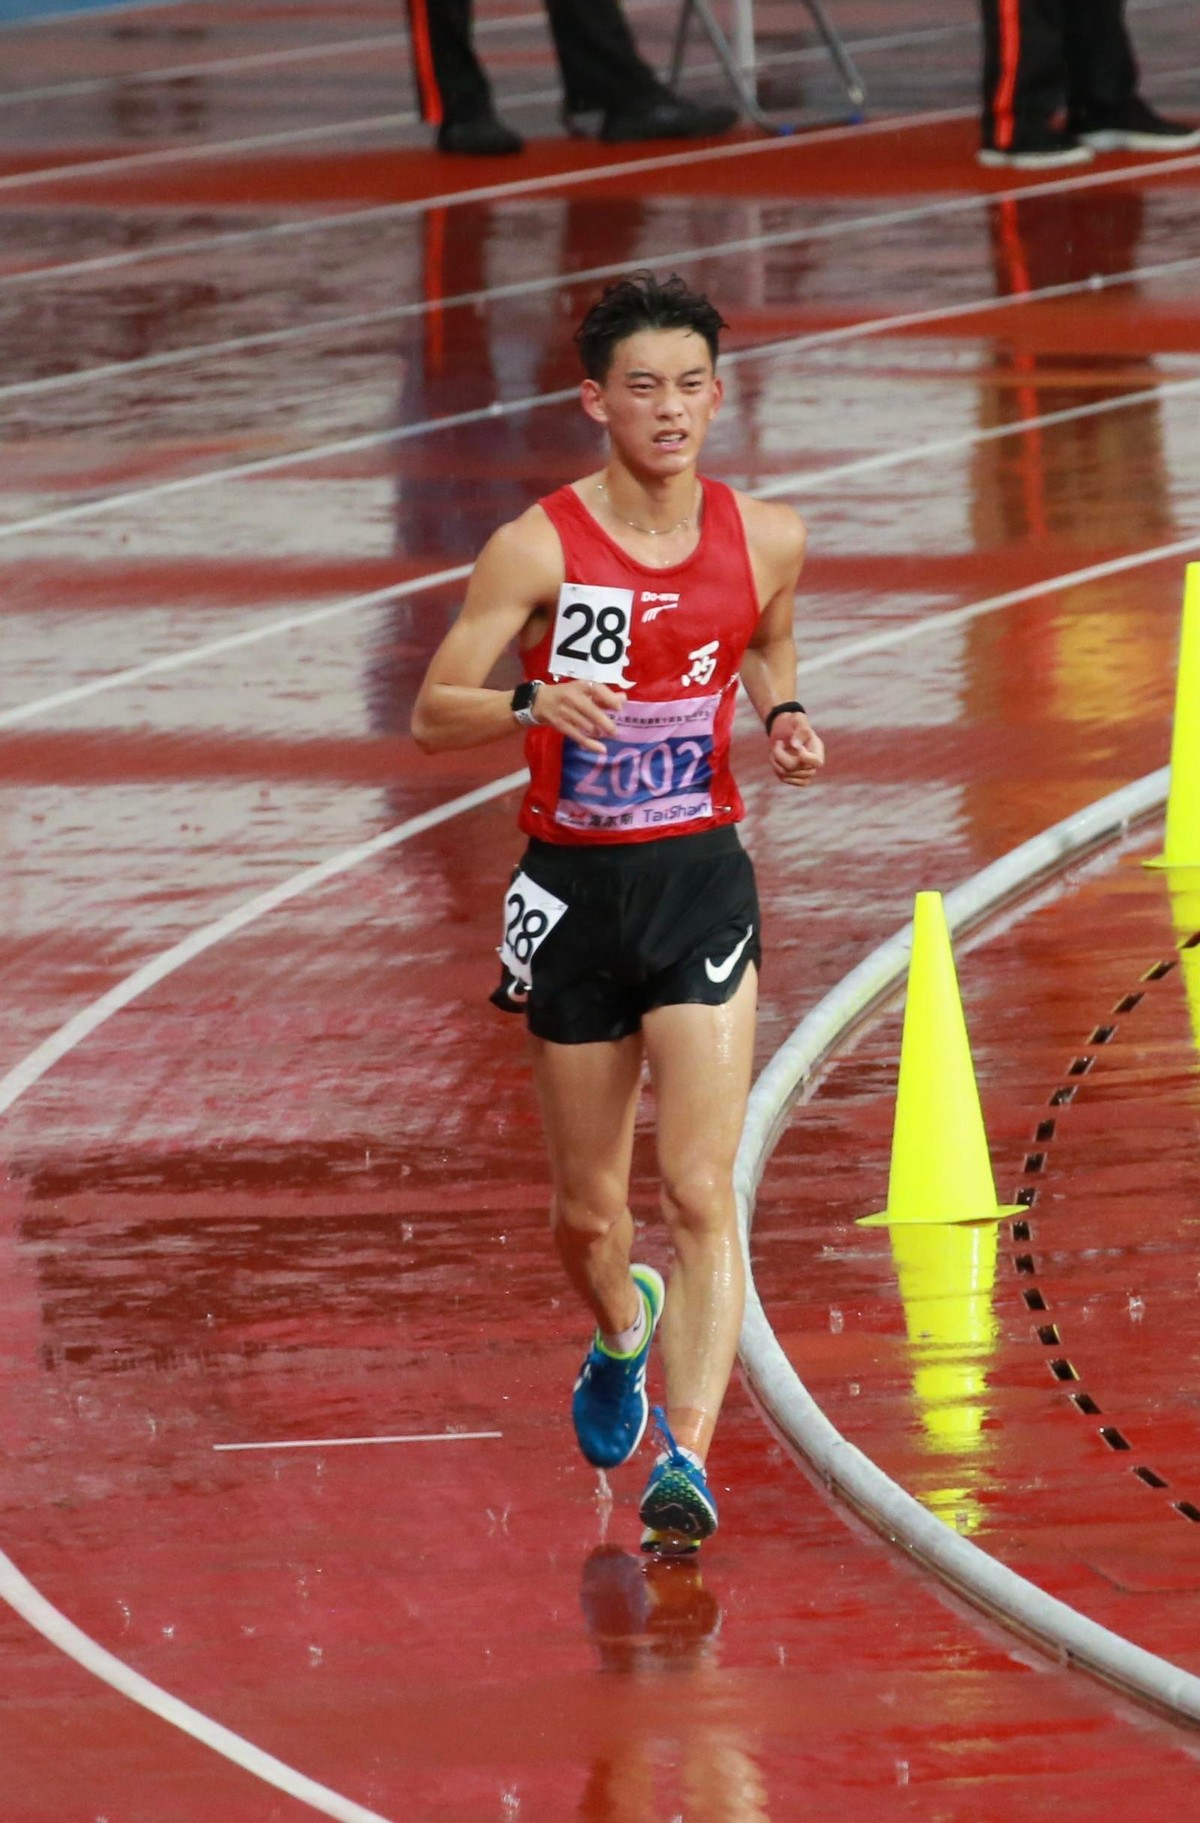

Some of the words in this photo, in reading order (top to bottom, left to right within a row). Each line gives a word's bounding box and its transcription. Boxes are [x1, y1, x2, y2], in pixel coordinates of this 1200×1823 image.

[556, 603, 626, 665] 28
[575, 741, 703, 798] 2002
[506, 893, 549, 965] 28
